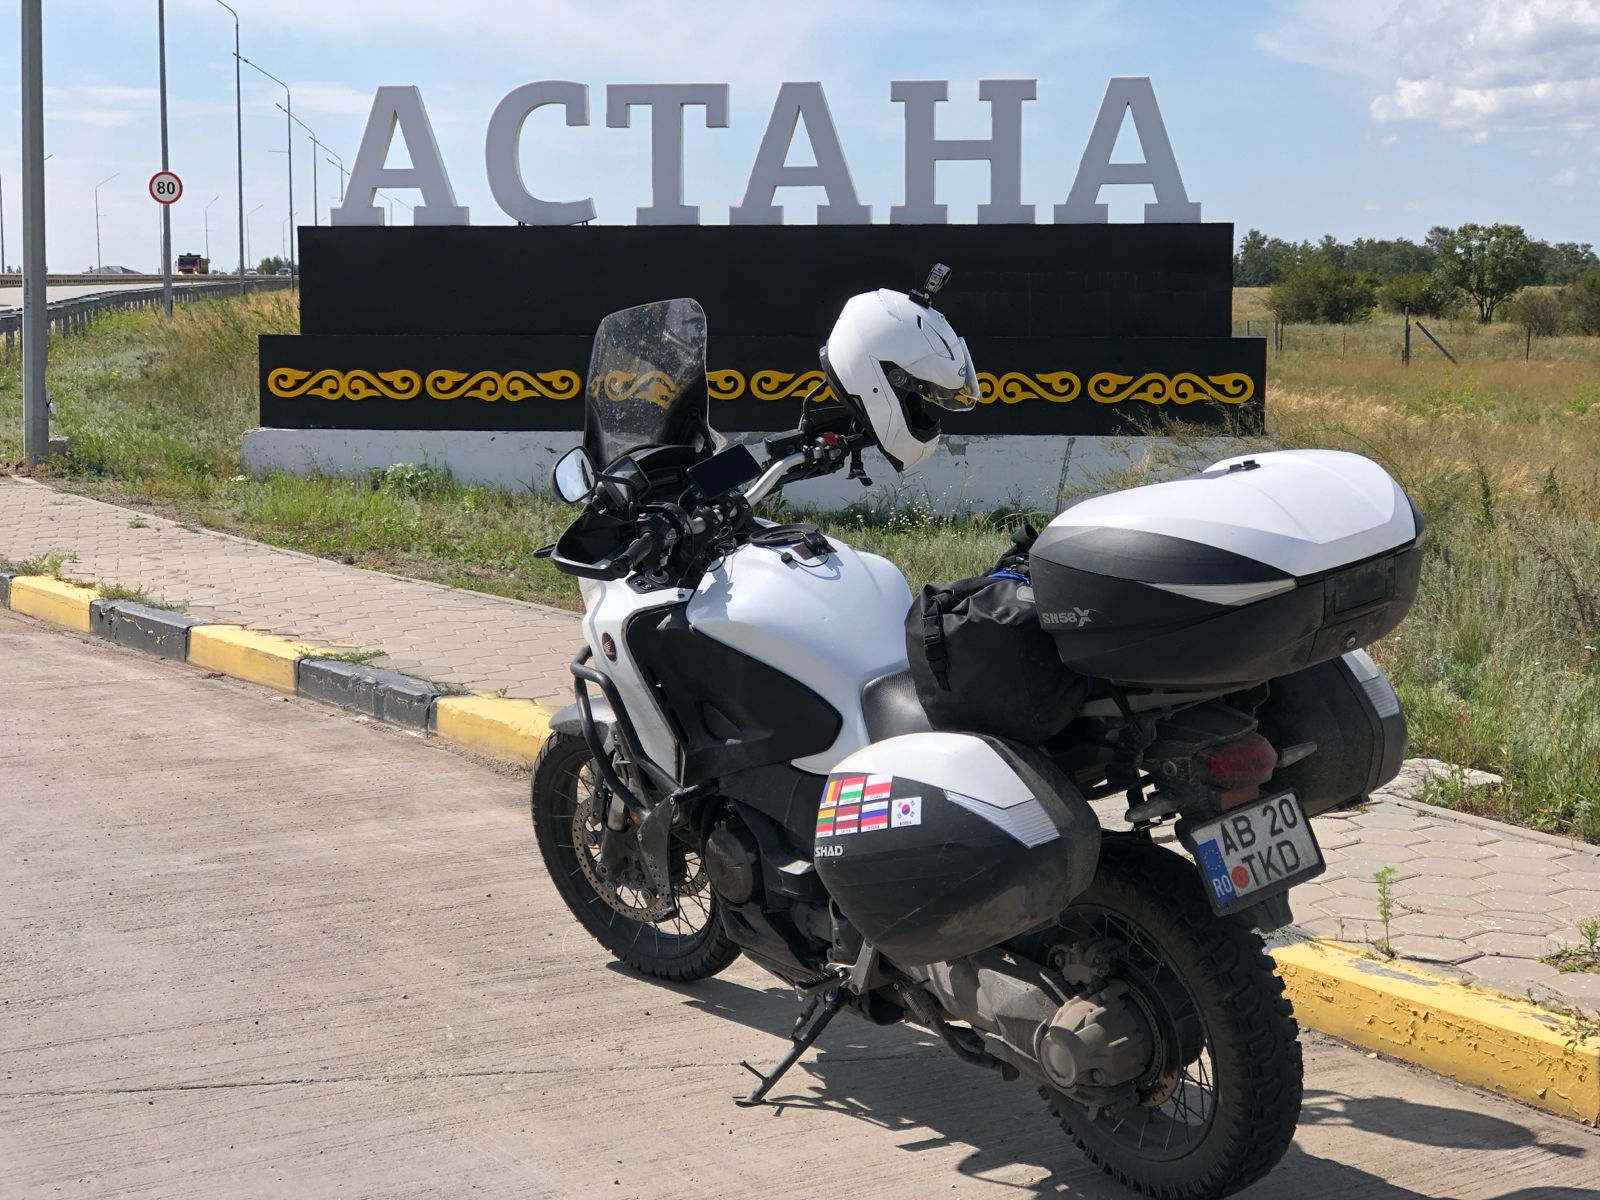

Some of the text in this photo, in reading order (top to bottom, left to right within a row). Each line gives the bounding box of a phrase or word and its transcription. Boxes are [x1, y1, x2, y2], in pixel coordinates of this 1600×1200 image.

[330, 76, 1202, 226] АСТАНА
[156, 181, 176, 195] 80
[1041, 606, 1097, 628] SH58X
[1220, 798, 1298, 856] AB 20
[815, 845, 844, 858] SHAD
[1241, 839, 1301, 887] TKD
[1213, 874, 1233, 898] RO
